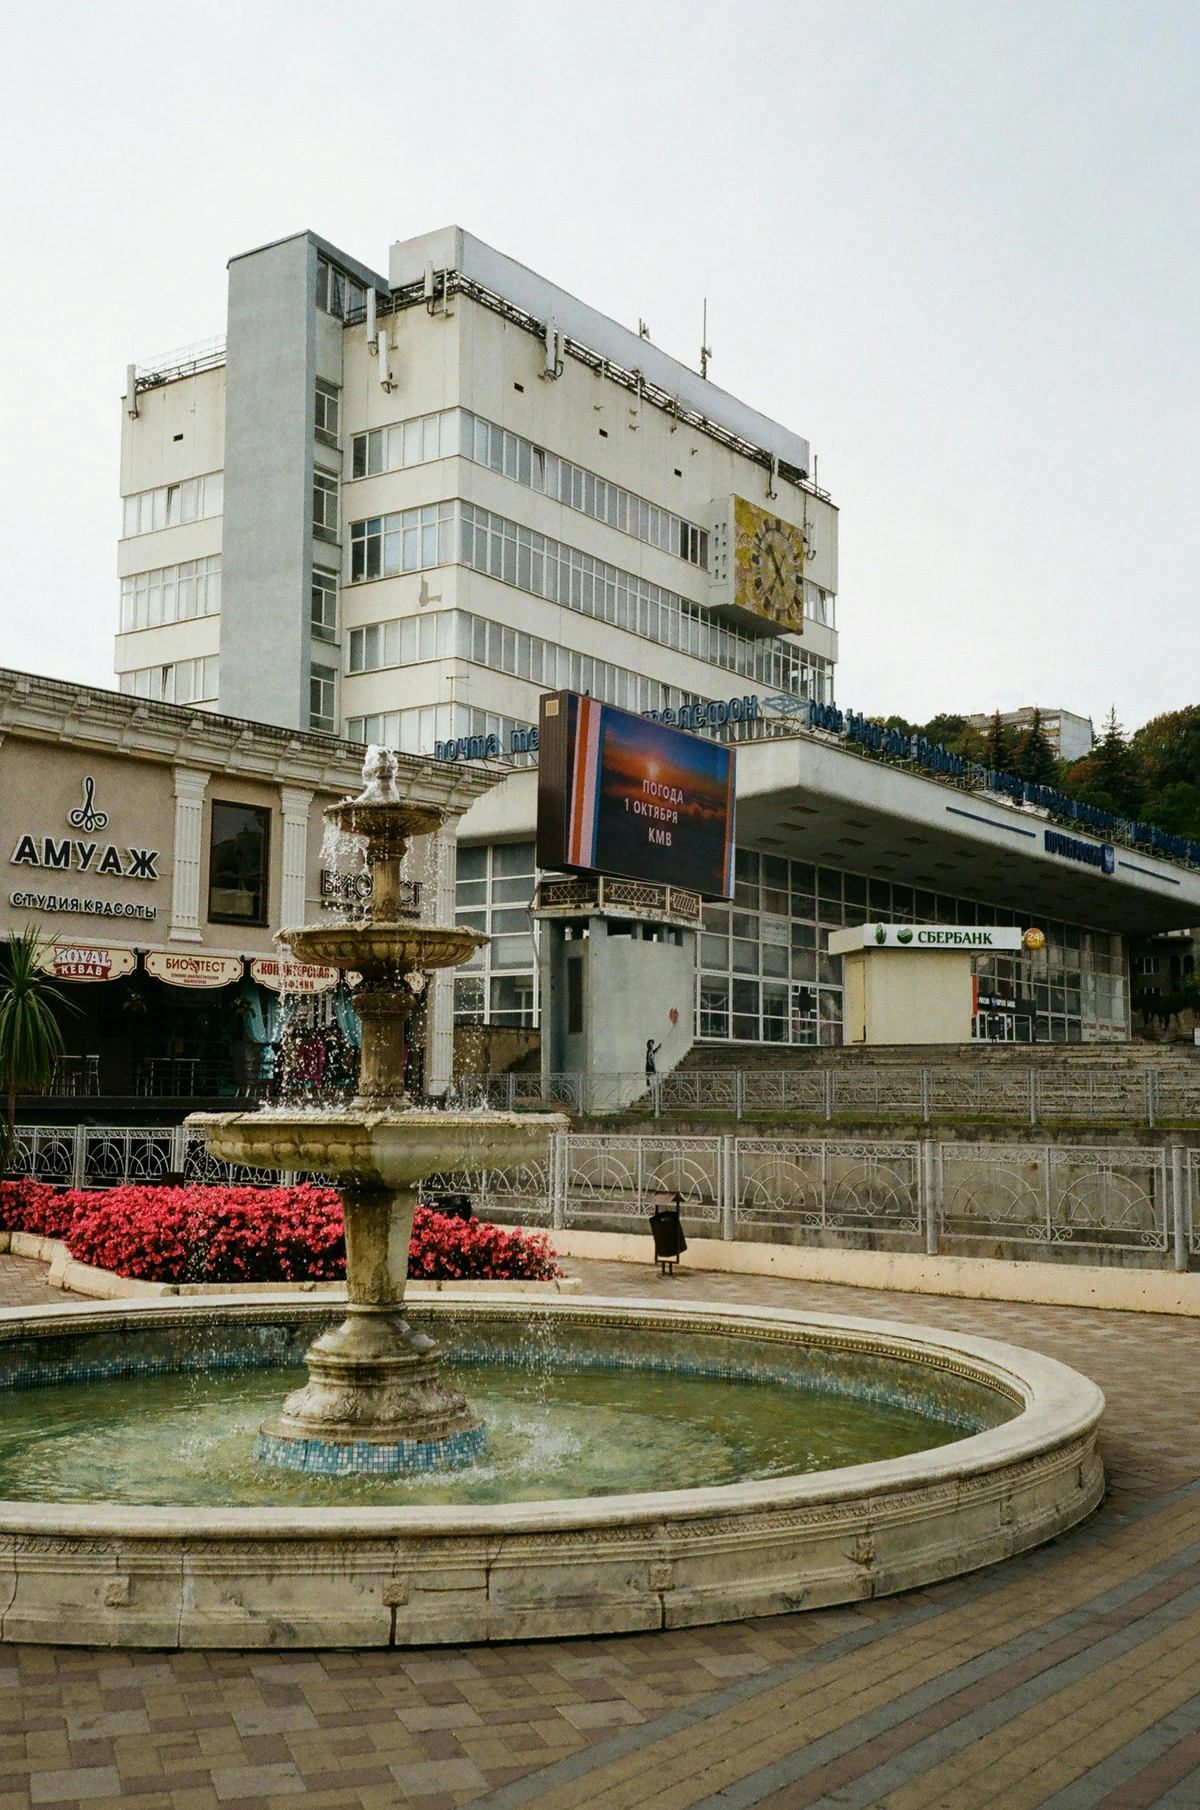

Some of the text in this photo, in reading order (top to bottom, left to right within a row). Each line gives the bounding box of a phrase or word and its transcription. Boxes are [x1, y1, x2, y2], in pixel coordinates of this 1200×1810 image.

[642, 695, 758, 732] телефон
[435, 734, 500, 761] почта
[643, 780, 684, 805] ПОГОДА
[624, 797, 678, 825] 1 ОКТЯБРЯ
[648, 827, 672, 847] КМВ
[12, 834, 160, 879] АМУАЖ
[12, 892, 157, 919] СТУДИЯ КРАСОТЫ
[917, 931, 993, 945] СБЕРБАНК
[61, 964, 103, 976] KEBAB
